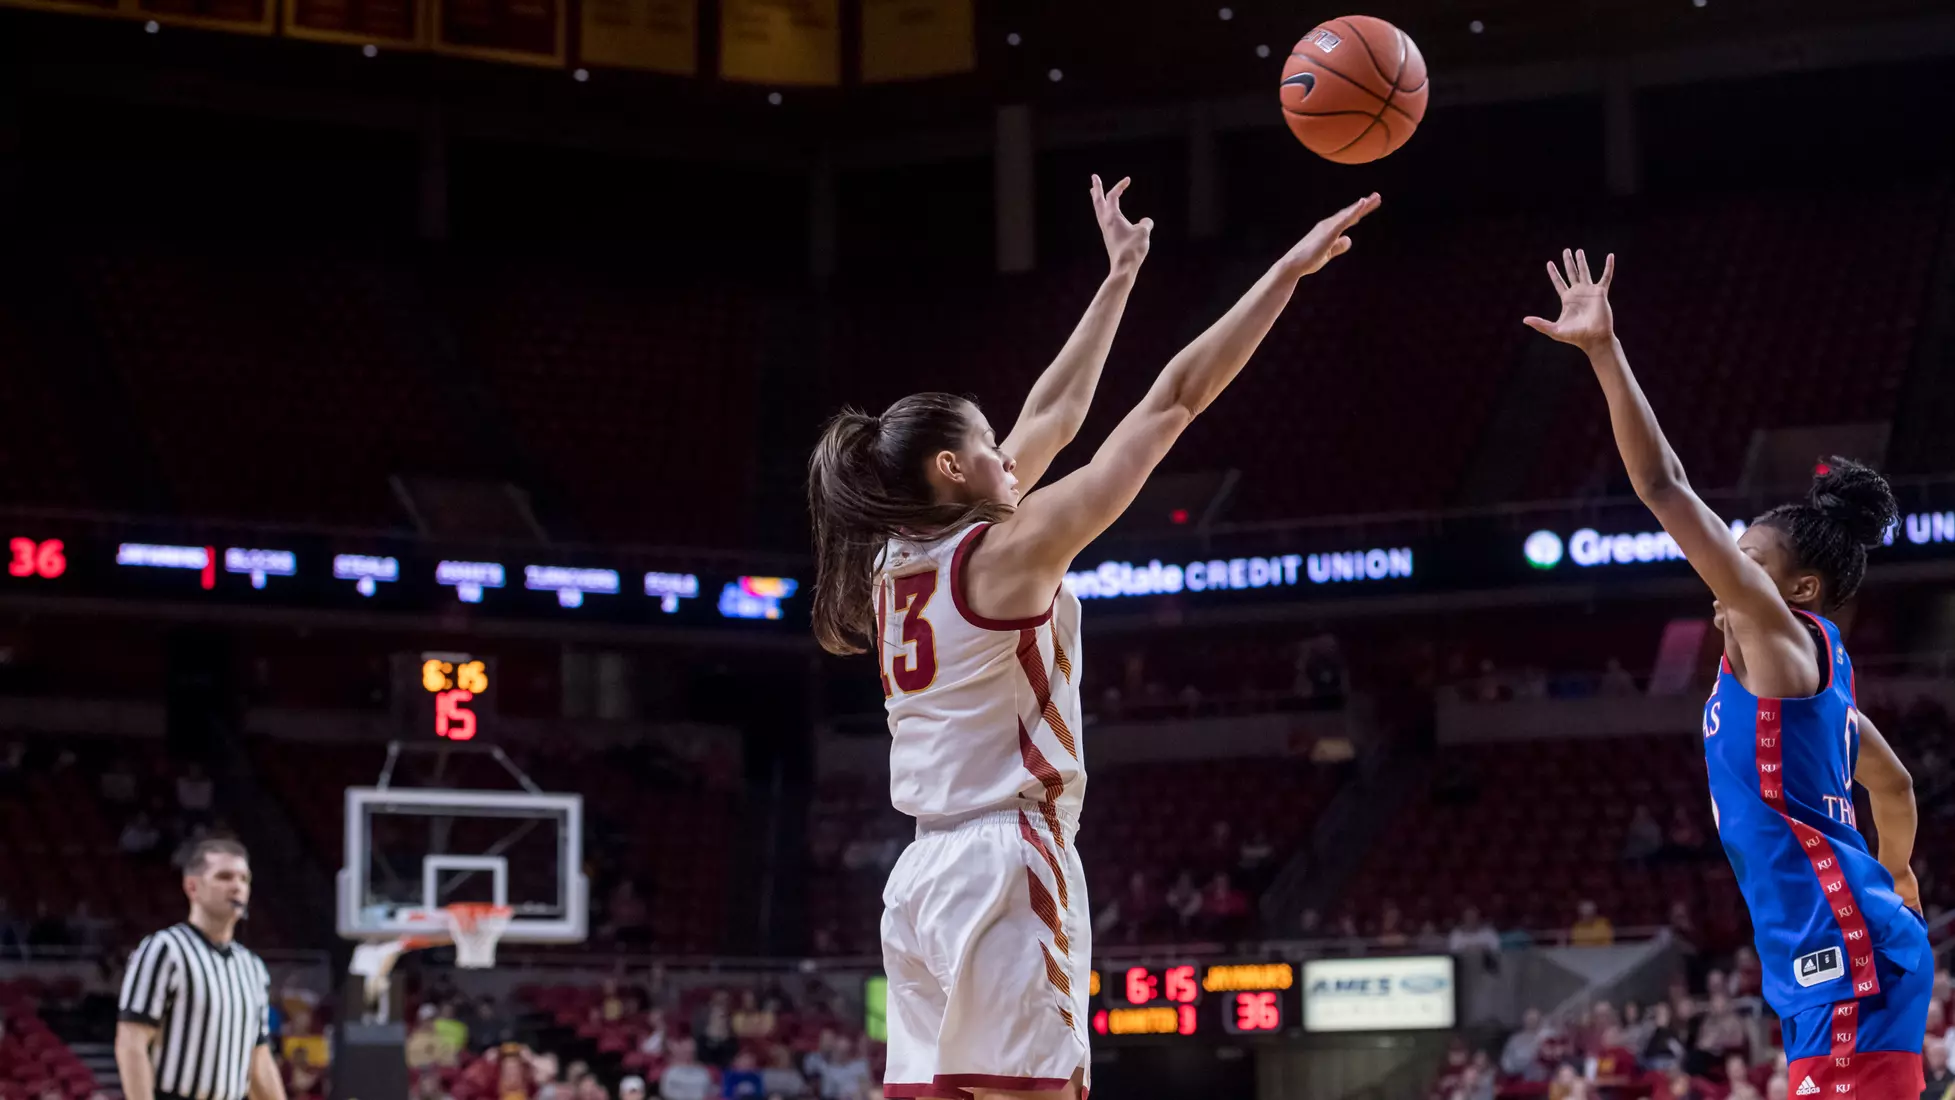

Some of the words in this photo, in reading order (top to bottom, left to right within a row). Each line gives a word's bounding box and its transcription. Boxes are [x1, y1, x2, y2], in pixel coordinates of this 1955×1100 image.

[1569, 527, 1687, 567] Green
[8, 537, 67, 580] 36
[1184, 554, 1302, 592] CREDIT
[1306, 547, 1413, 584] UNION
[435, 689, 477, 741] 15
[1761, 711, 1776, 722] KU
[1761, 738, 1776, 748] KU
[1761, 763, 1777, 773] KU
[1764, 789, 1778, 799] KU
[1805, 835, 1821, 848] KU
[1817, 858, 1832, 870] KU
[1827, 880, 1842, 893] KU
[1838, 905, 1854, 918] KU
[1848, 929, 1863, 940] KU
[1855, 955, 1869, 967] KU
[1126, 965, 1198, 1005] 6:15
[1858, 980, 1873, 991] KU
[1236, 991, 1280, 1031] 36
[1837, 1006, 1853, 1016] KU
[1836, 1032, 1851, 1043] KU
[1835, 1057, 1850, 1068] KU
[1836, 1083, 1851, 1094] KU
